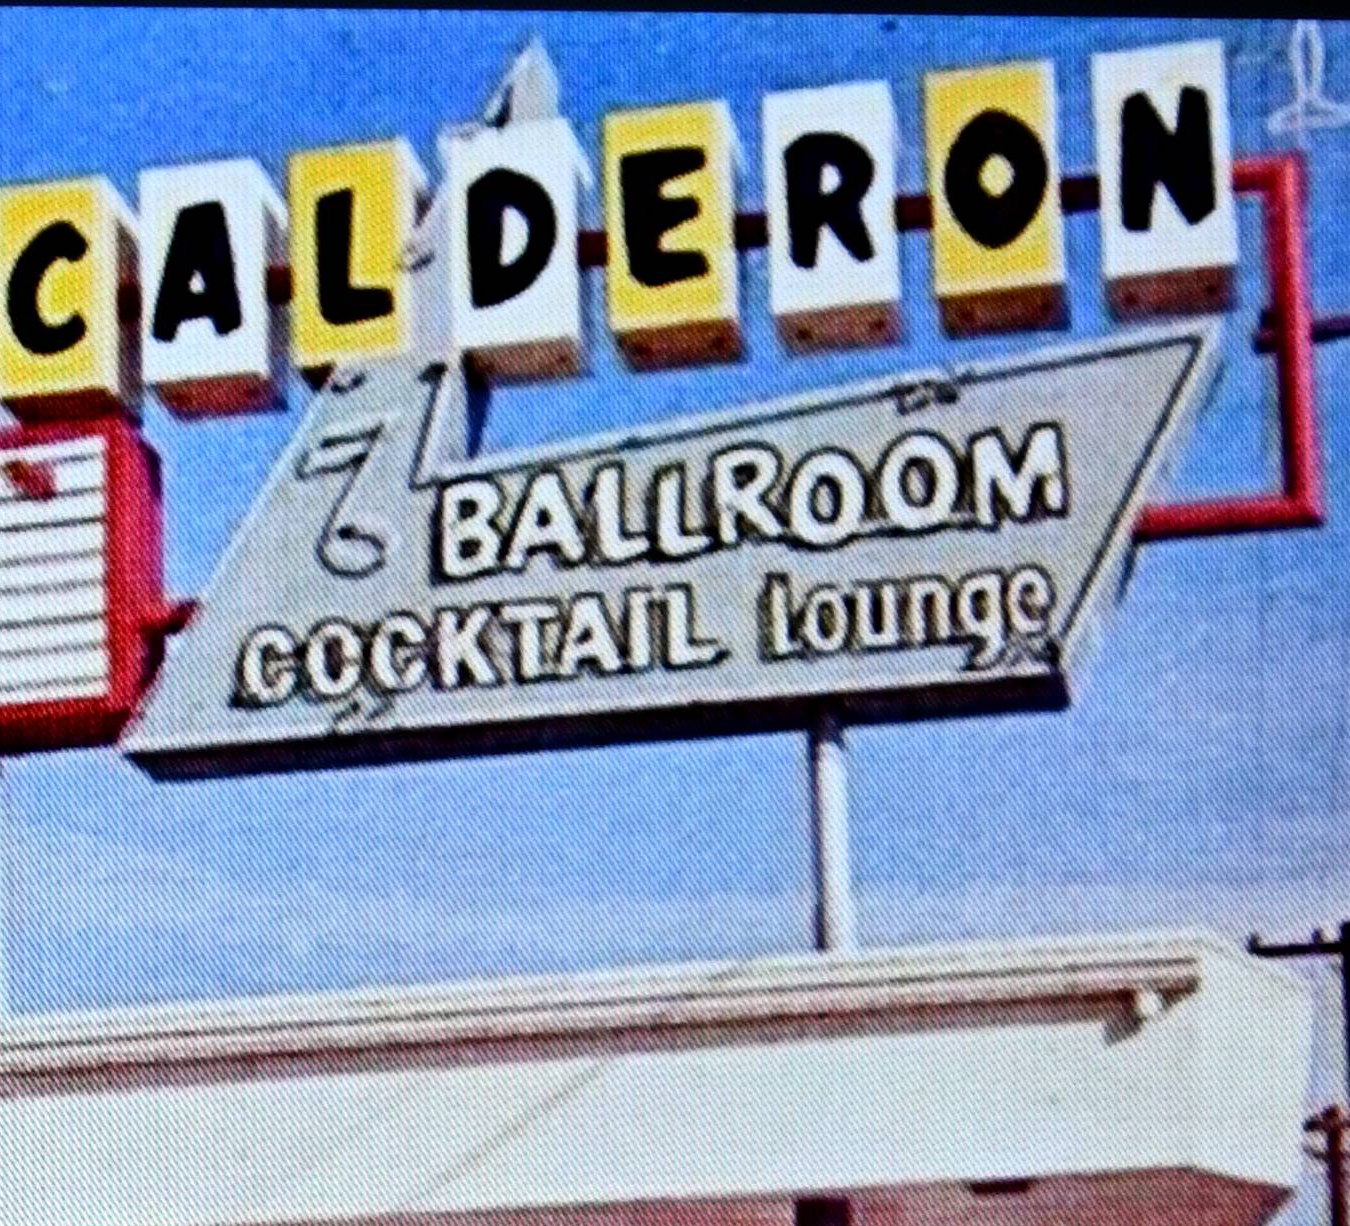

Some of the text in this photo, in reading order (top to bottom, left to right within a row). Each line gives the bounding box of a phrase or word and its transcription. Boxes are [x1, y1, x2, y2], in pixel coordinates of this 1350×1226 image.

[5, 84, 1216, 355] CALDERON
[434, 424, 1066, 583] BALLROOM
[236, 562, 1054, 708] COCKTAIL lounge
